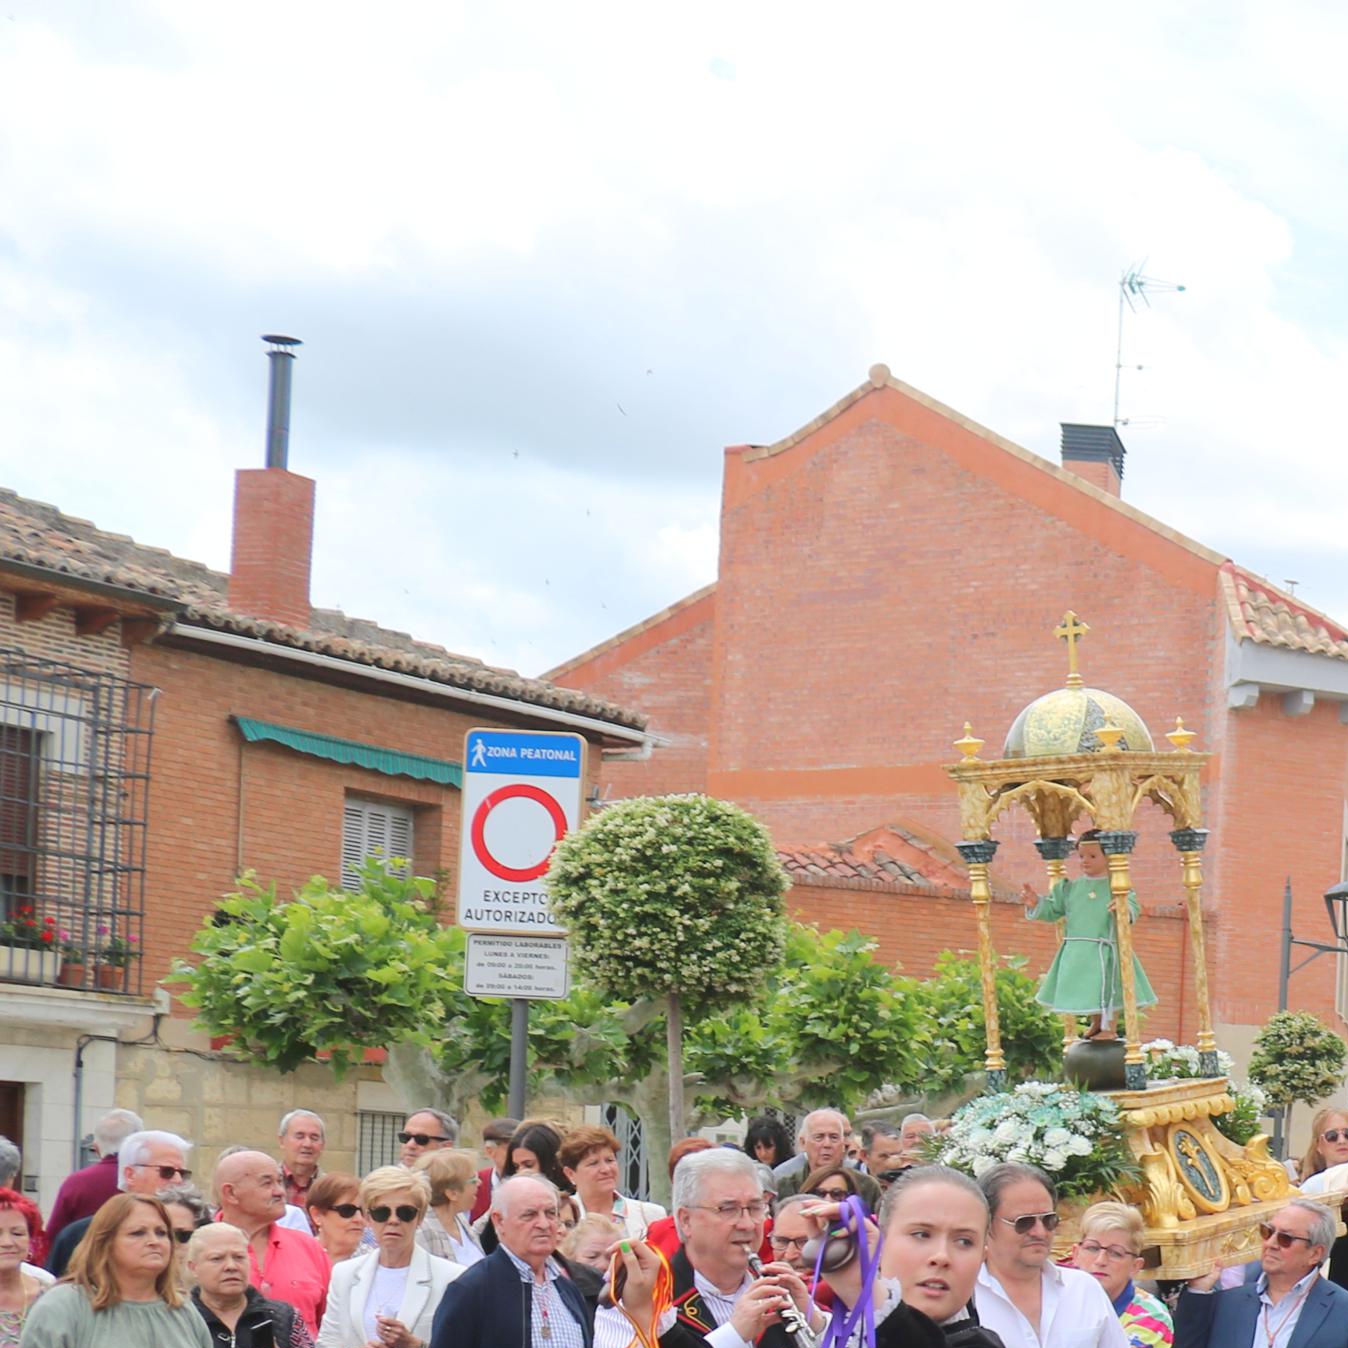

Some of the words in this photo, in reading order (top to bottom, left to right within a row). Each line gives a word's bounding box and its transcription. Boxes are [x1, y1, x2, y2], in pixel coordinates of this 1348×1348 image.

[487, 746, 518, 758] ZONA
[520, 747, 577, 761] PEATONAL
[483, 890, 549, 905] EXCEPTO
[464, 908, 558, 925] AUTORIZADO
[514, 941, 562, 949] LABORABLES
